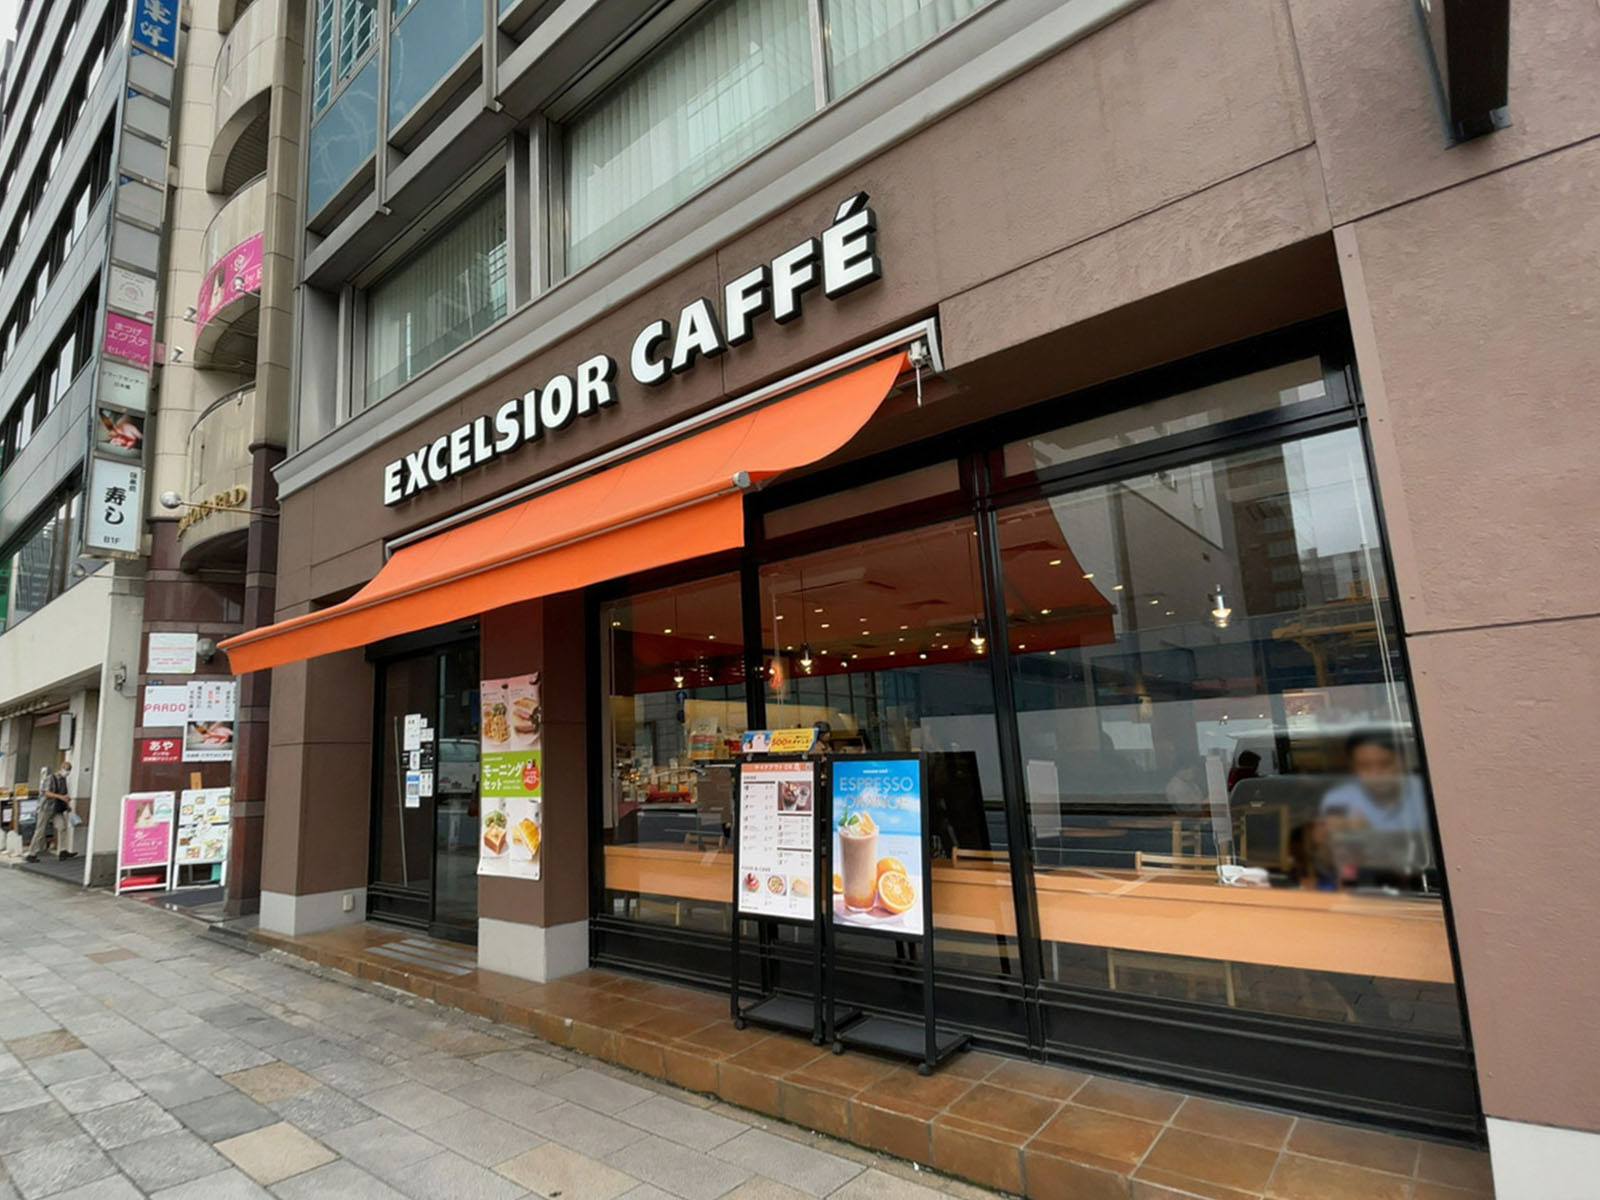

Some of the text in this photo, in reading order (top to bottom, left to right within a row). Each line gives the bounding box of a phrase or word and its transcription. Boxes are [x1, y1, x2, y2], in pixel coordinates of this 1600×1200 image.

[107, 330, 148, 346] エクステ
[384, 192, 881, 506] EXCELSIOR CAFFÉ
[104, 486, 126, 525] 寿し
[149, 741, 174, 752] あや
[483, 760, 525, 778] モーニング
[483, 779, 502, 791] セット
[839, 776, 914, 792] ESPRESSO
